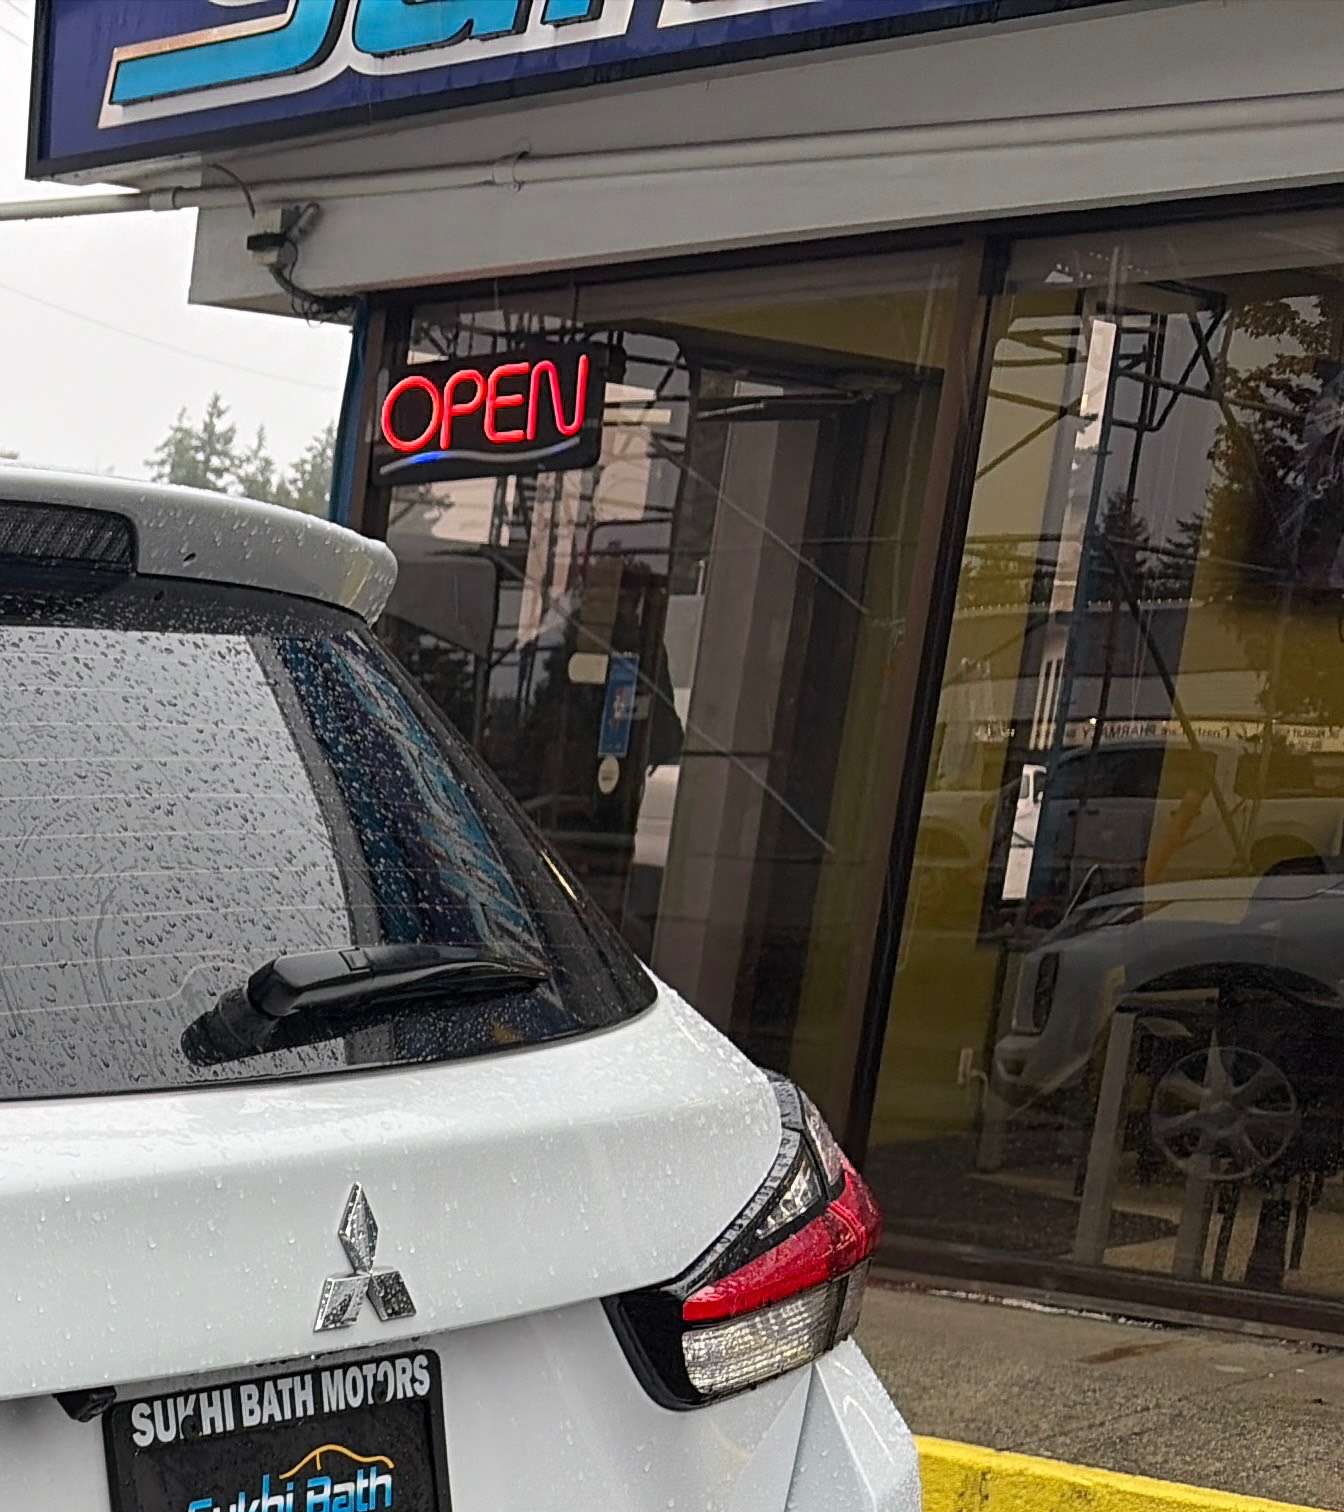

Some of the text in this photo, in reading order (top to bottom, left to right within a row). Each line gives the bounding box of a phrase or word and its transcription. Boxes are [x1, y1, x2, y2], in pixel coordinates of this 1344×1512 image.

[381, 354, 589, 453] OPEN
[131, 1353, 431, 1447] SUKHI BATH MOTORS
